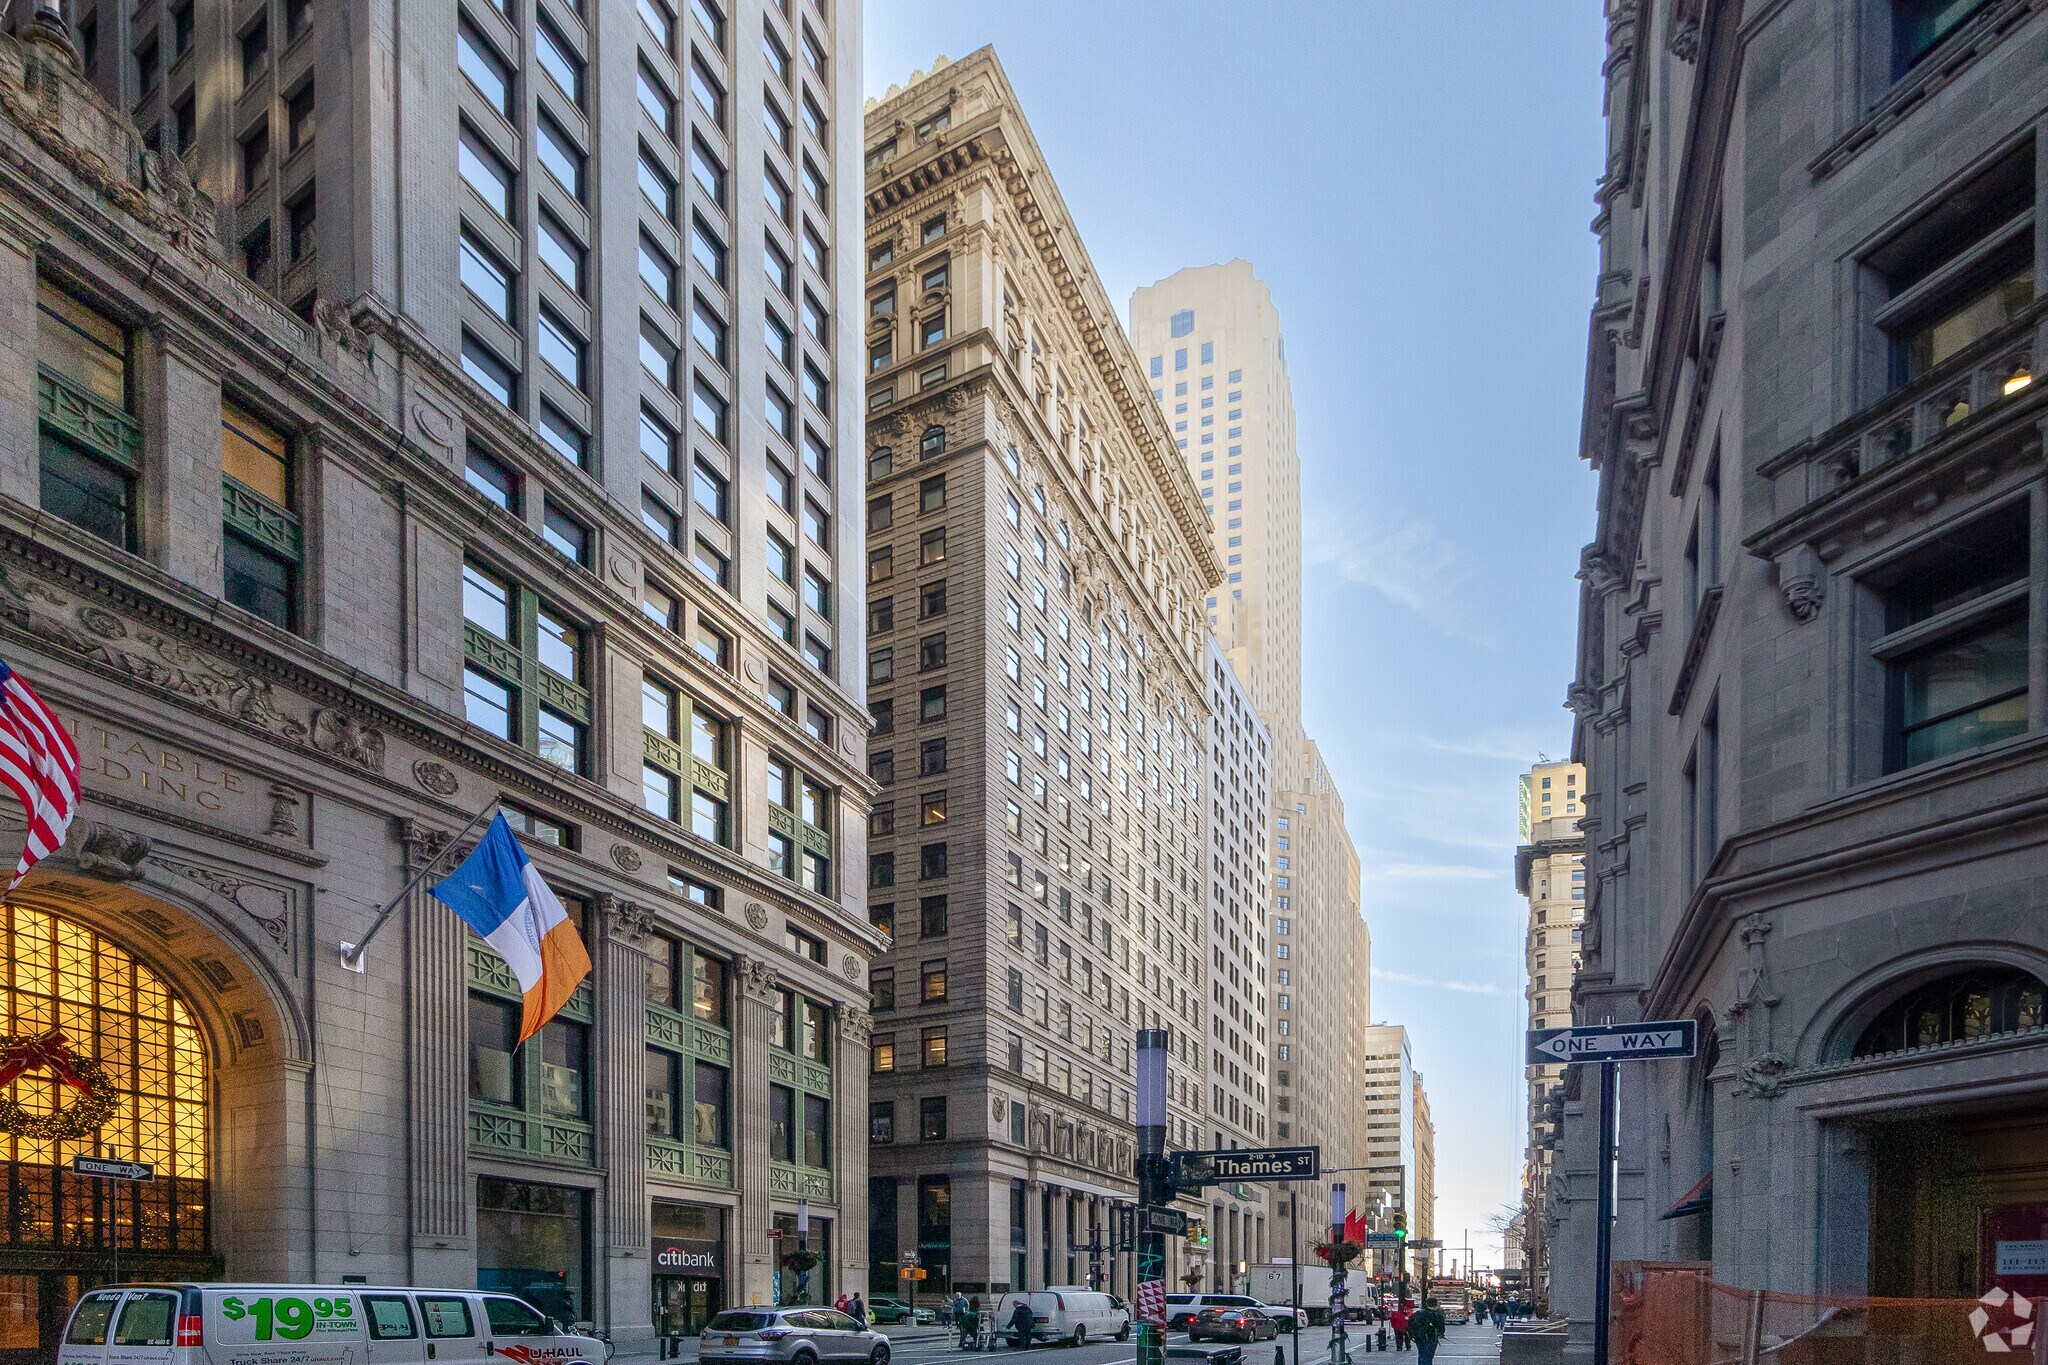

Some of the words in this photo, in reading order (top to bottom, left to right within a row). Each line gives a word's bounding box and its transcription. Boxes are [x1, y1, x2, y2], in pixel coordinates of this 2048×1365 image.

[1552, 1037, 1597, 1053] ONE
[1621, 1033, 1671, 1049] WAY
[85, 1162, 109, 1172] ONE
[119, 1166, 142, 1175] WAY
[1217, 1160, 1292, 1175] Thames
[1297, 1156, 1310, 1165] ST
[658, 1248, 715, 1267] citibank
[97, 1293, 115, 1301] Need
[316, 1321, 357, 1329] IN-TOWN
[530, 1348, 583, 1358] U-HAUL
[230, 1357, 258, 1365] Truck
[290, 1355, 310, 1364] 24/7
